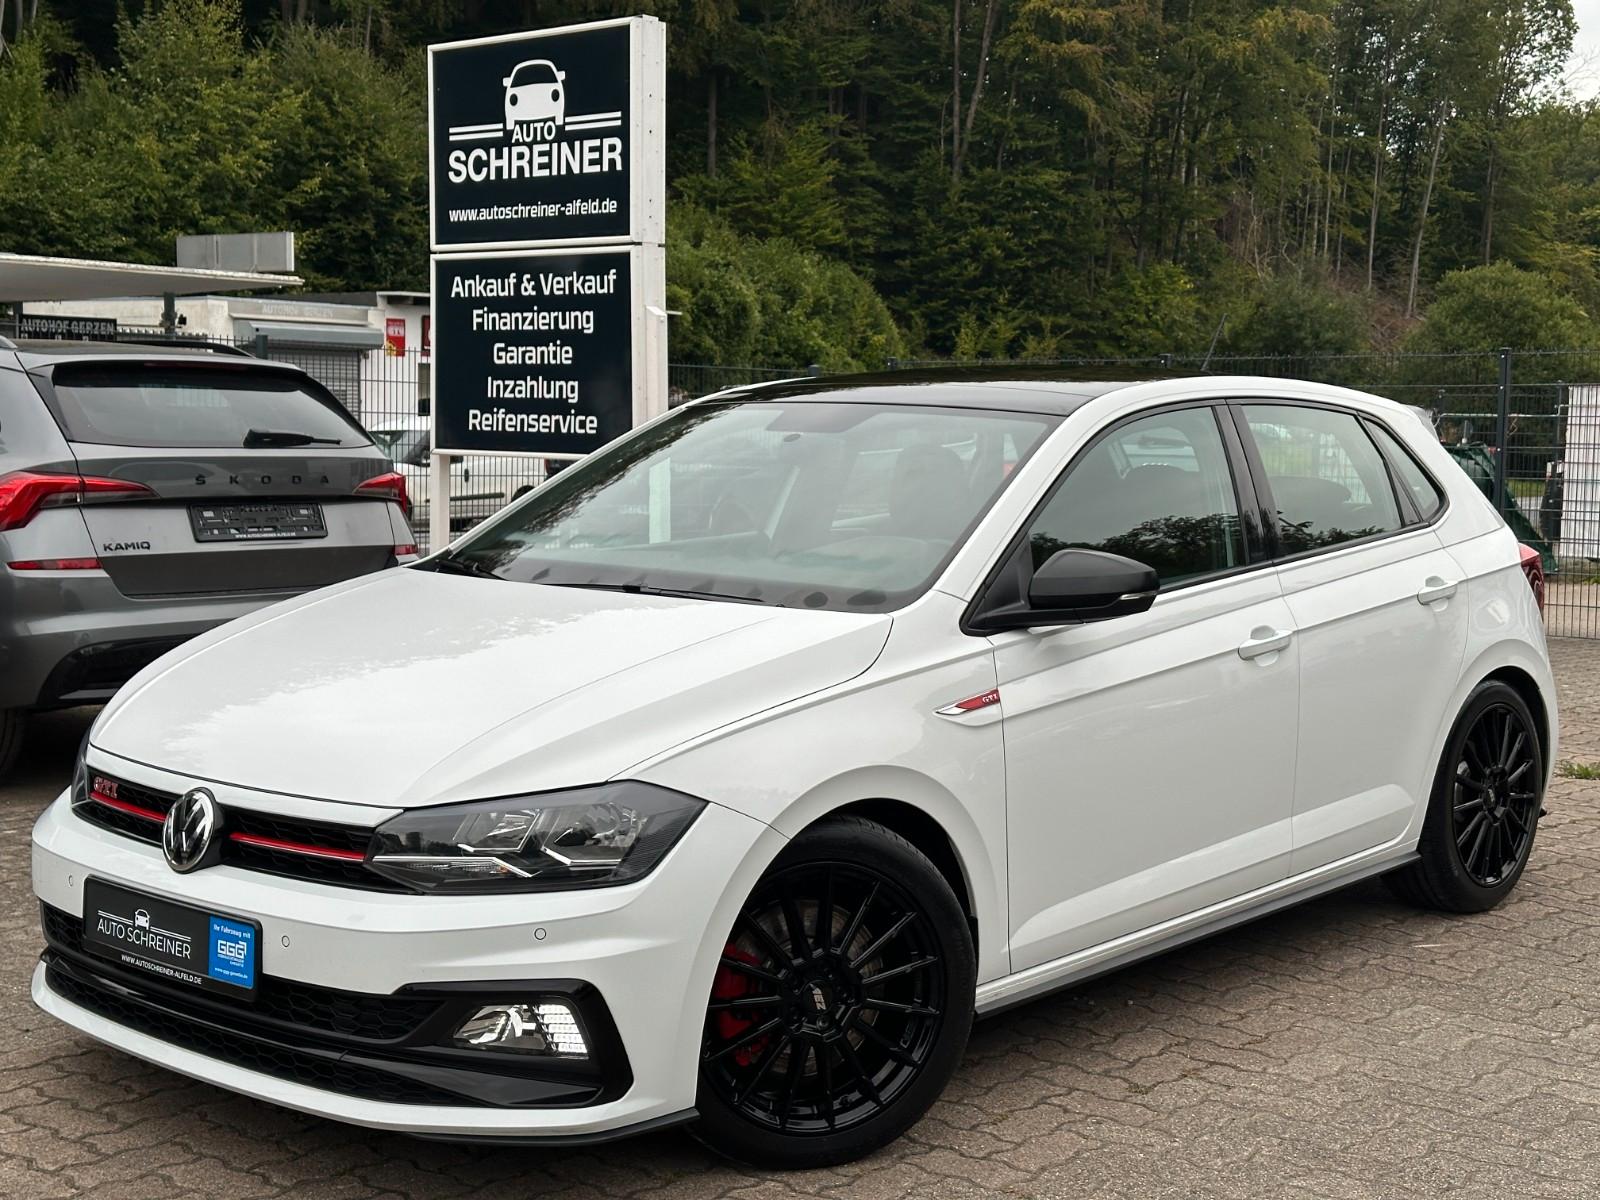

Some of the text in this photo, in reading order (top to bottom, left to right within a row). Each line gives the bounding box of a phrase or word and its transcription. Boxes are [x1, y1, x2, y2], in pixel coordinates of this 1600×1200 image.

[511, 121, 556, 143] AUTO
[448, 136, 623, 184] SCHREINER
[449, 197, 618, 223] www.autoschreiner-alfeld.de
[450, 268, 617, 298] Ankauf & Verkauf
[20, 317, 115, 336] AUTOHOF GERZEN
[472, 305, 594, 334] Finanzierung
[492, 339, 573, 365] Garantie
[487, 375, 579, 403] Inzahlung
[468, 407, 598, 434] Reifenservice
[103, 540, 151, 552] KAMIQ
[982, 693, 998, 703] GTI
[93, 776, 119, 799] GTI
[97, 918, 192, 960] AUTO SCHREINER
[217, 939, 247, 960] GGG
[121, 953, 203, 985] WWW.AUTOSCHREINER-ALFELD.DE
